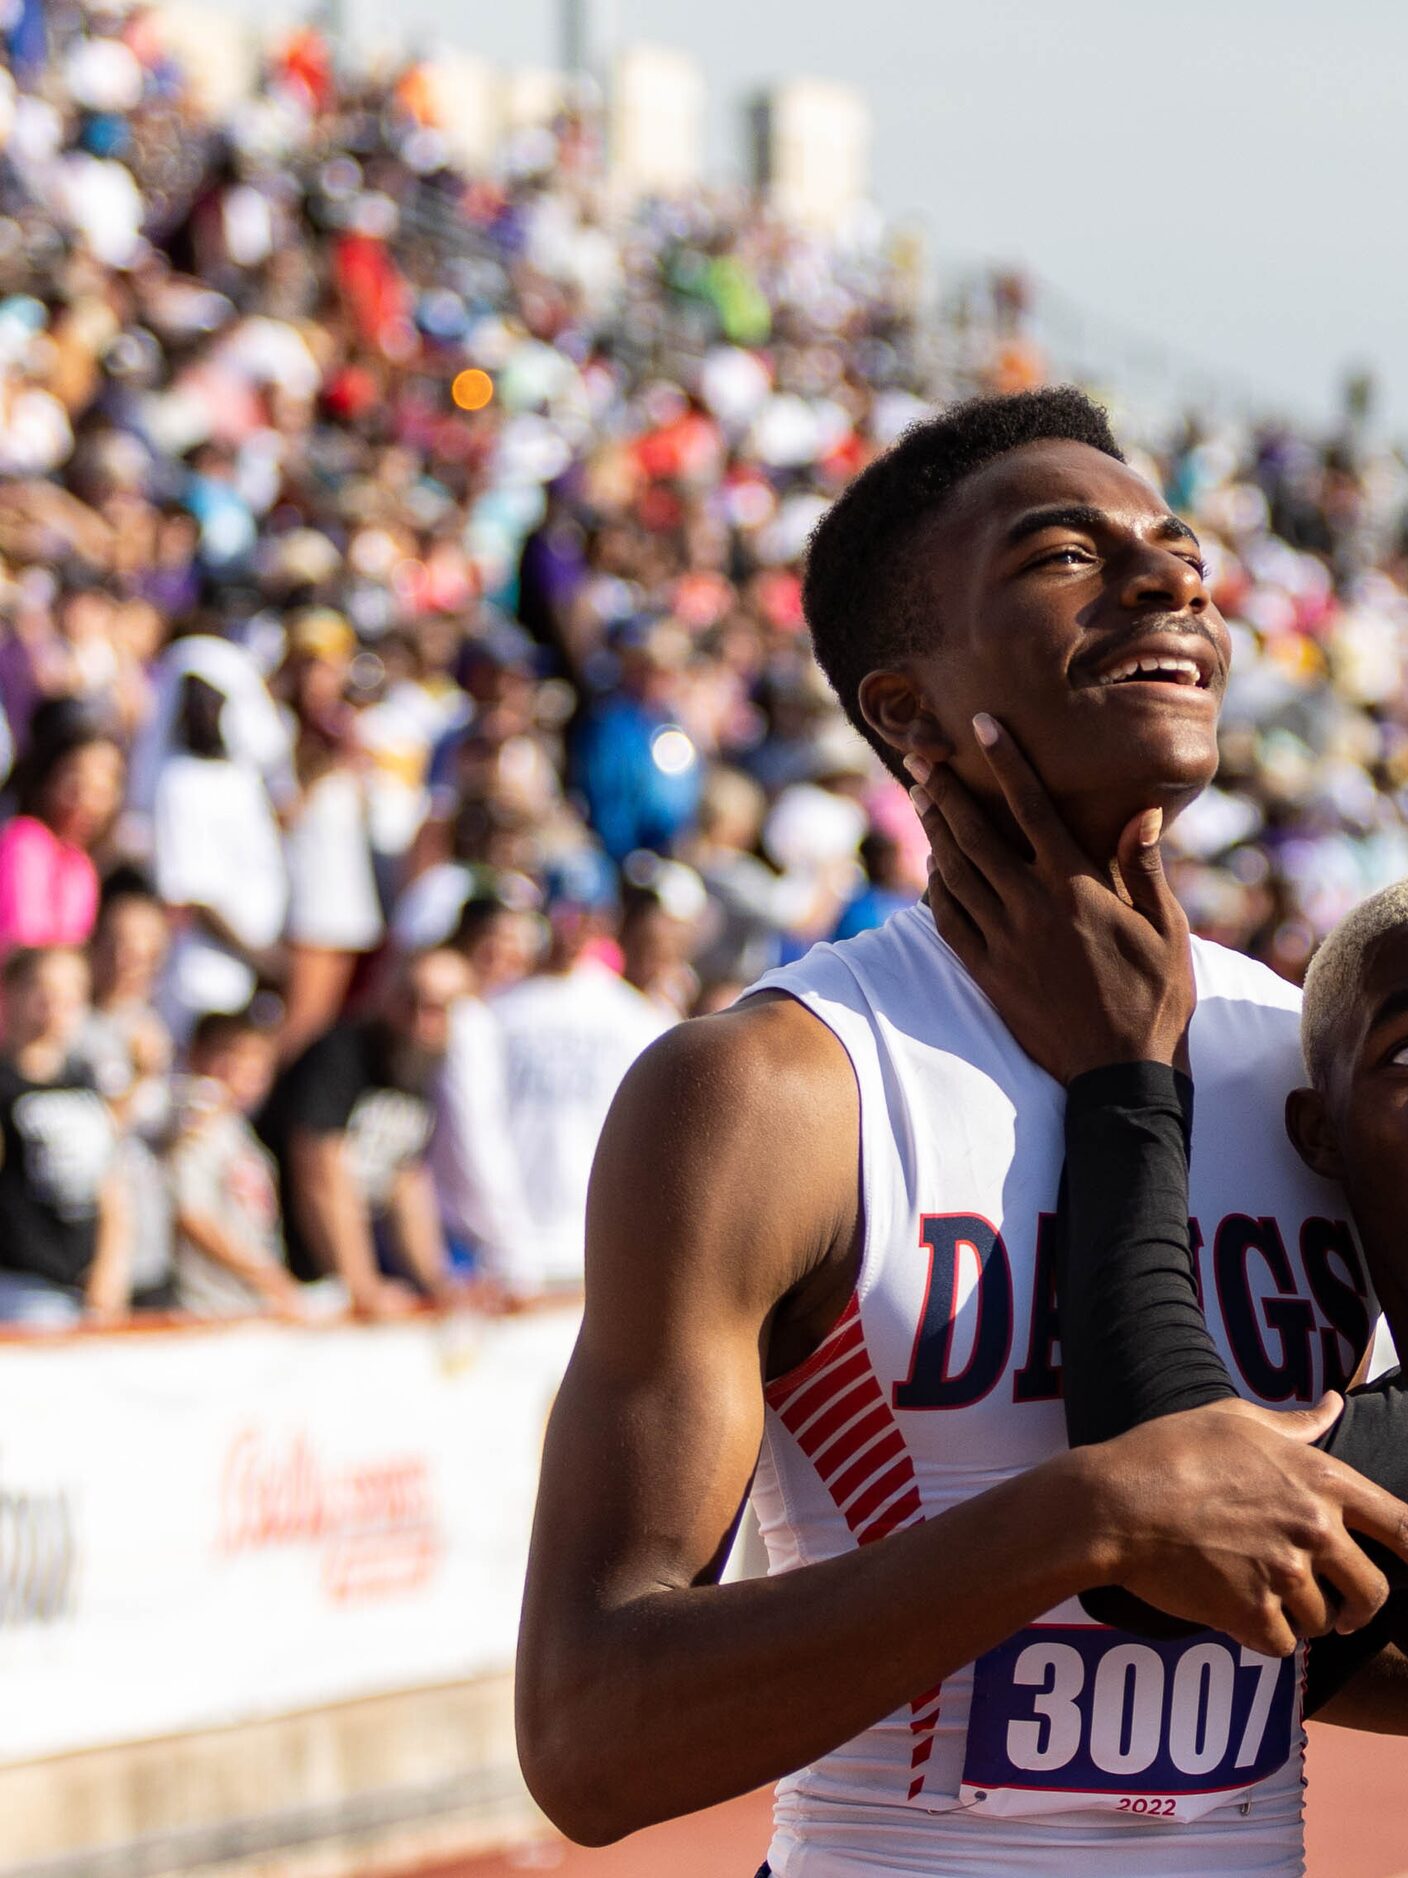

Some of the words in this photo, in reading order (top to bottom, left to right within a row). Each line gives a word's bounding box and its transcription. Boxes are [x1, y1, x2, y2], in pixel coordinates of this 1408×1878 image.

[892, 1211, 1370, 1411] DAGS
[1006, 1642, 1283, 1775] 3007
[1115, 1798, 1177, 1816] 2022
